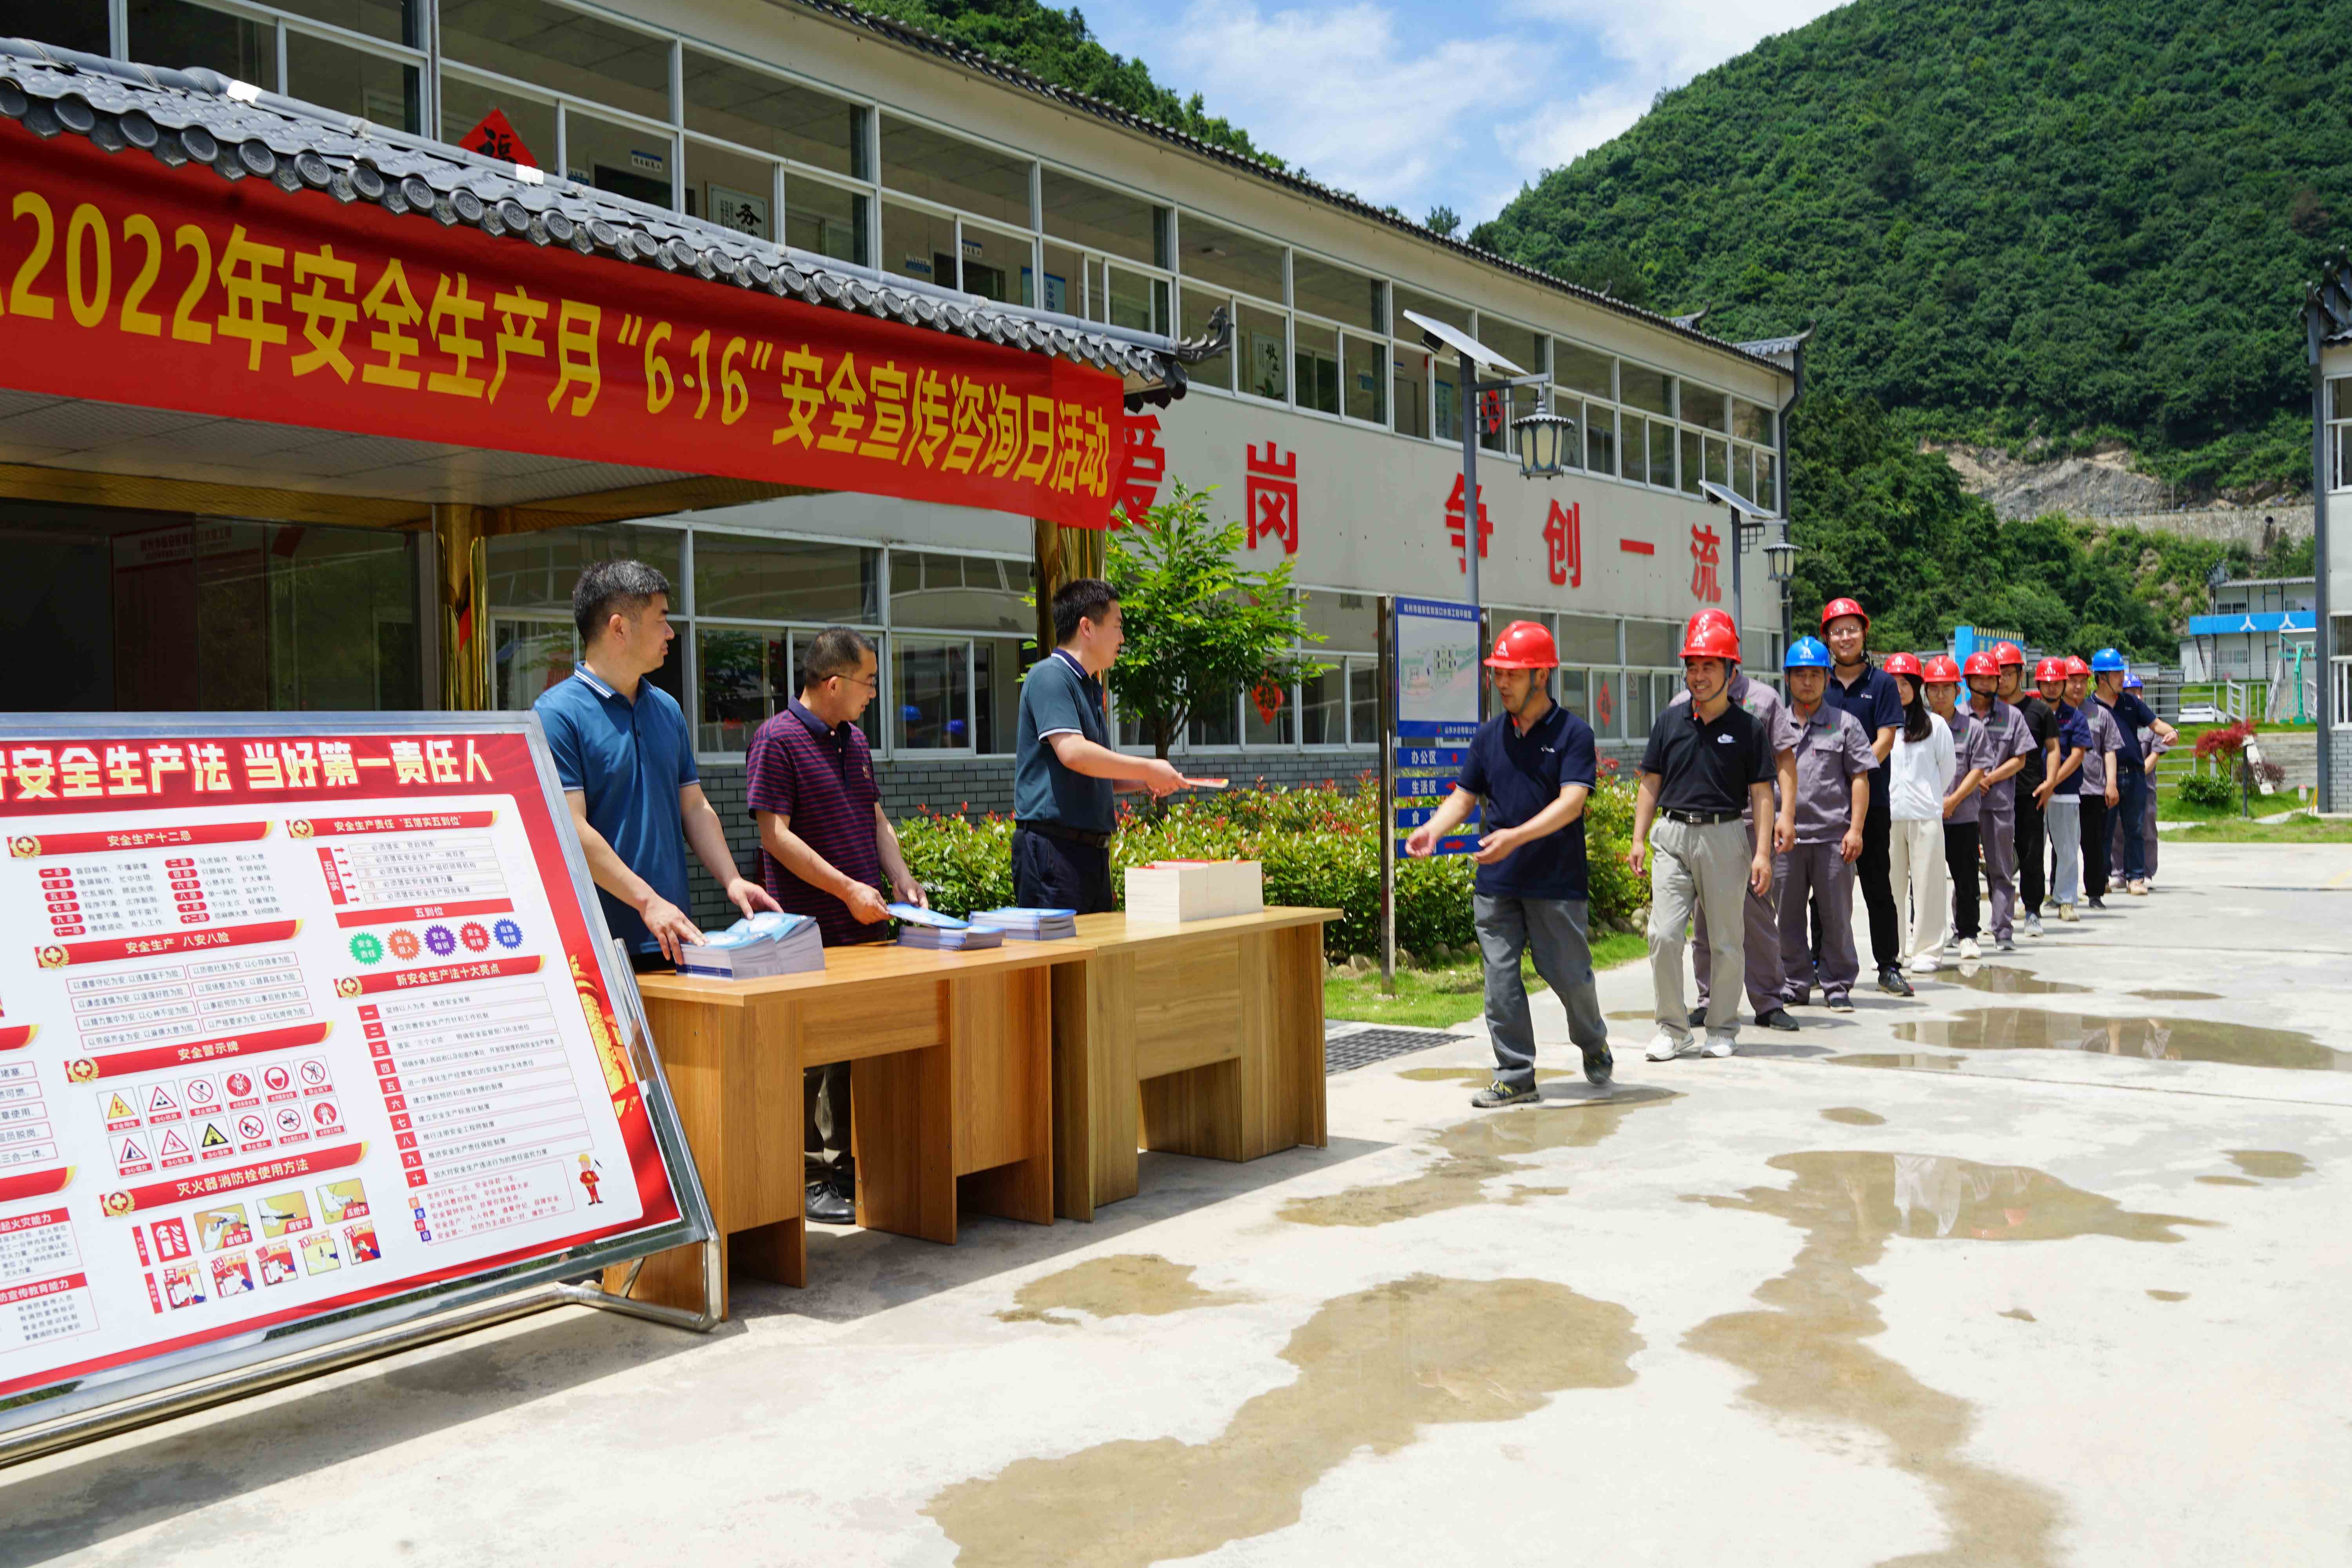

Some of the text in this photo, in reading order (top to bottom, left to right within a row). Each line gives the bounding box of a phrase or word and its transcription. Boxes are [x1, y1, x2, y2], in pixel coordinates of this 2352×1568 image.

[0, 191, 1109, 498] 2022年安全生产月“6·16”安全宣传咨询日活动
[1445, 473, 1722, 604] 争创一流
[1411, 750, 1437, 764] 办公区
[0, 739, 493, 800] 安全生产法 当好第一责任人
[1412, 779, 1437, 795] 生活区
[107, 830, 192, 847] 安全生产十二忌
[43, 868, 64, 876] 一忌
[323, 860, 341, 891] 五落实
[45, 880, 68, 888] 三忌
[176, 881, 195, 889] 六忌
[50, 892, 70, 900] 五忌
[179, 892, 198, 900] 八忌
[52, 903, 73, 912] 七忌
[414, 906, 444, 918] 五到位
[56, 915, 76, 924] 九忌
[183, 914, 207, 922] 十二忌
[56, 926, 82, 935] 十一忌
[466, 928, 481, 937] 安全
[500, 925, 514, 934] 应急
[395, 935, 411, 944] 安全
[432, 931, 448, 940] 安全
[503, 935, 517, 944] 救援
[125, 931, 231, 954] 安全生产 八安八险
[434, 941, 450, 951] 培训
[469, 938, 485, 947] 管理
[360, 949, 377, 958] 责任
[398, 945, 414, 954] 投入
[396, 963, 501, 987] 新安全生产法十大亮点
[370, 1027, 380, 1036] 二
[178, 1040, 240, 1061] 安全警示牌
[376, 1045, 385, 1054] 三
[381, 1063, 391, 1074] 四
[386, 1081, 396, 1092] 五
[391, 1099, 401, 1109] 六
[397, 1118, 407, 1128] 七
[403, 1136, 412, 1145] 八
[407, 1154, 417, 1165] 九
[176, 1158, 309, 1197] 灭火器消防栓使用方法
[412, 1173, 422, 1184] 十
